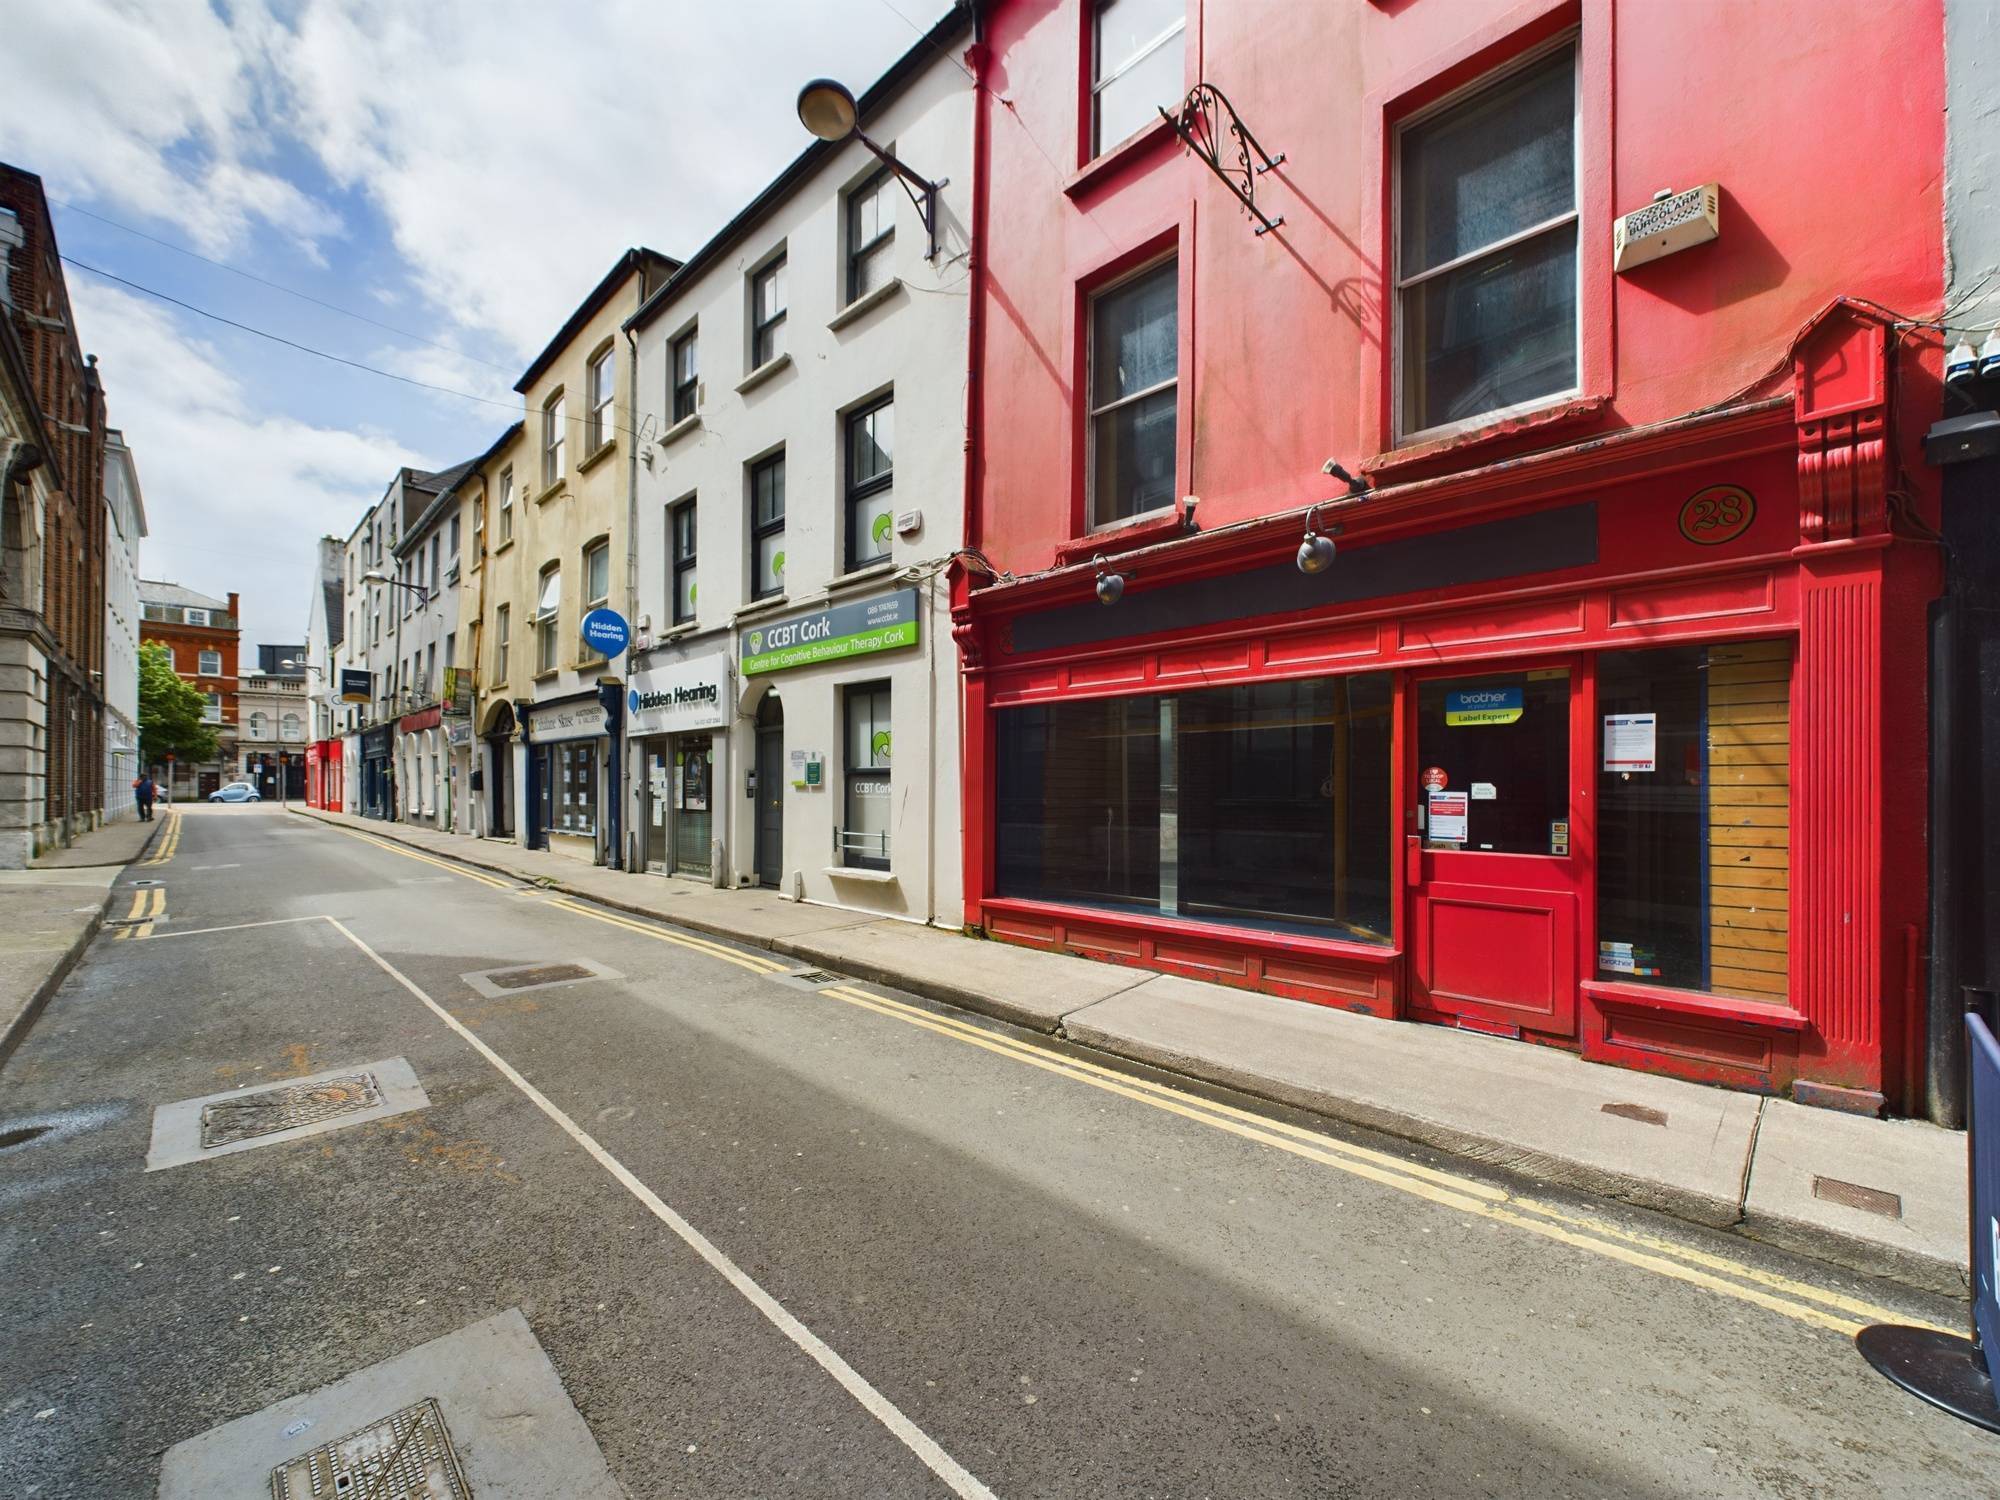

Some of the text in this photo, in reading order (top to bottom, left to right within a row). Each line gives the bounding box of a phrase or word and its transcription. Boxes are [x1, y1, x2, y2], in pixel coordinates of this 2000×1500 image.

[1629, 191, 1700, 236] BURGOLARM
[1693, 495, 1744, 532] 28
[589, 630, 624, 642] Hearing
[591, 621, 623, 632] Hidden
[767, 616, 831, 648] CCBT Cork
[750, 628, 904, 671] Centre for Cognitive Behaviour Therapy Cork
[639, 682, 717, 709] Hidden Hearing
[1460, 692, 1507, 704] brother
[1458, 713, 1510, 722] Label Expert
[855, 782, 874, 794] CCBT
